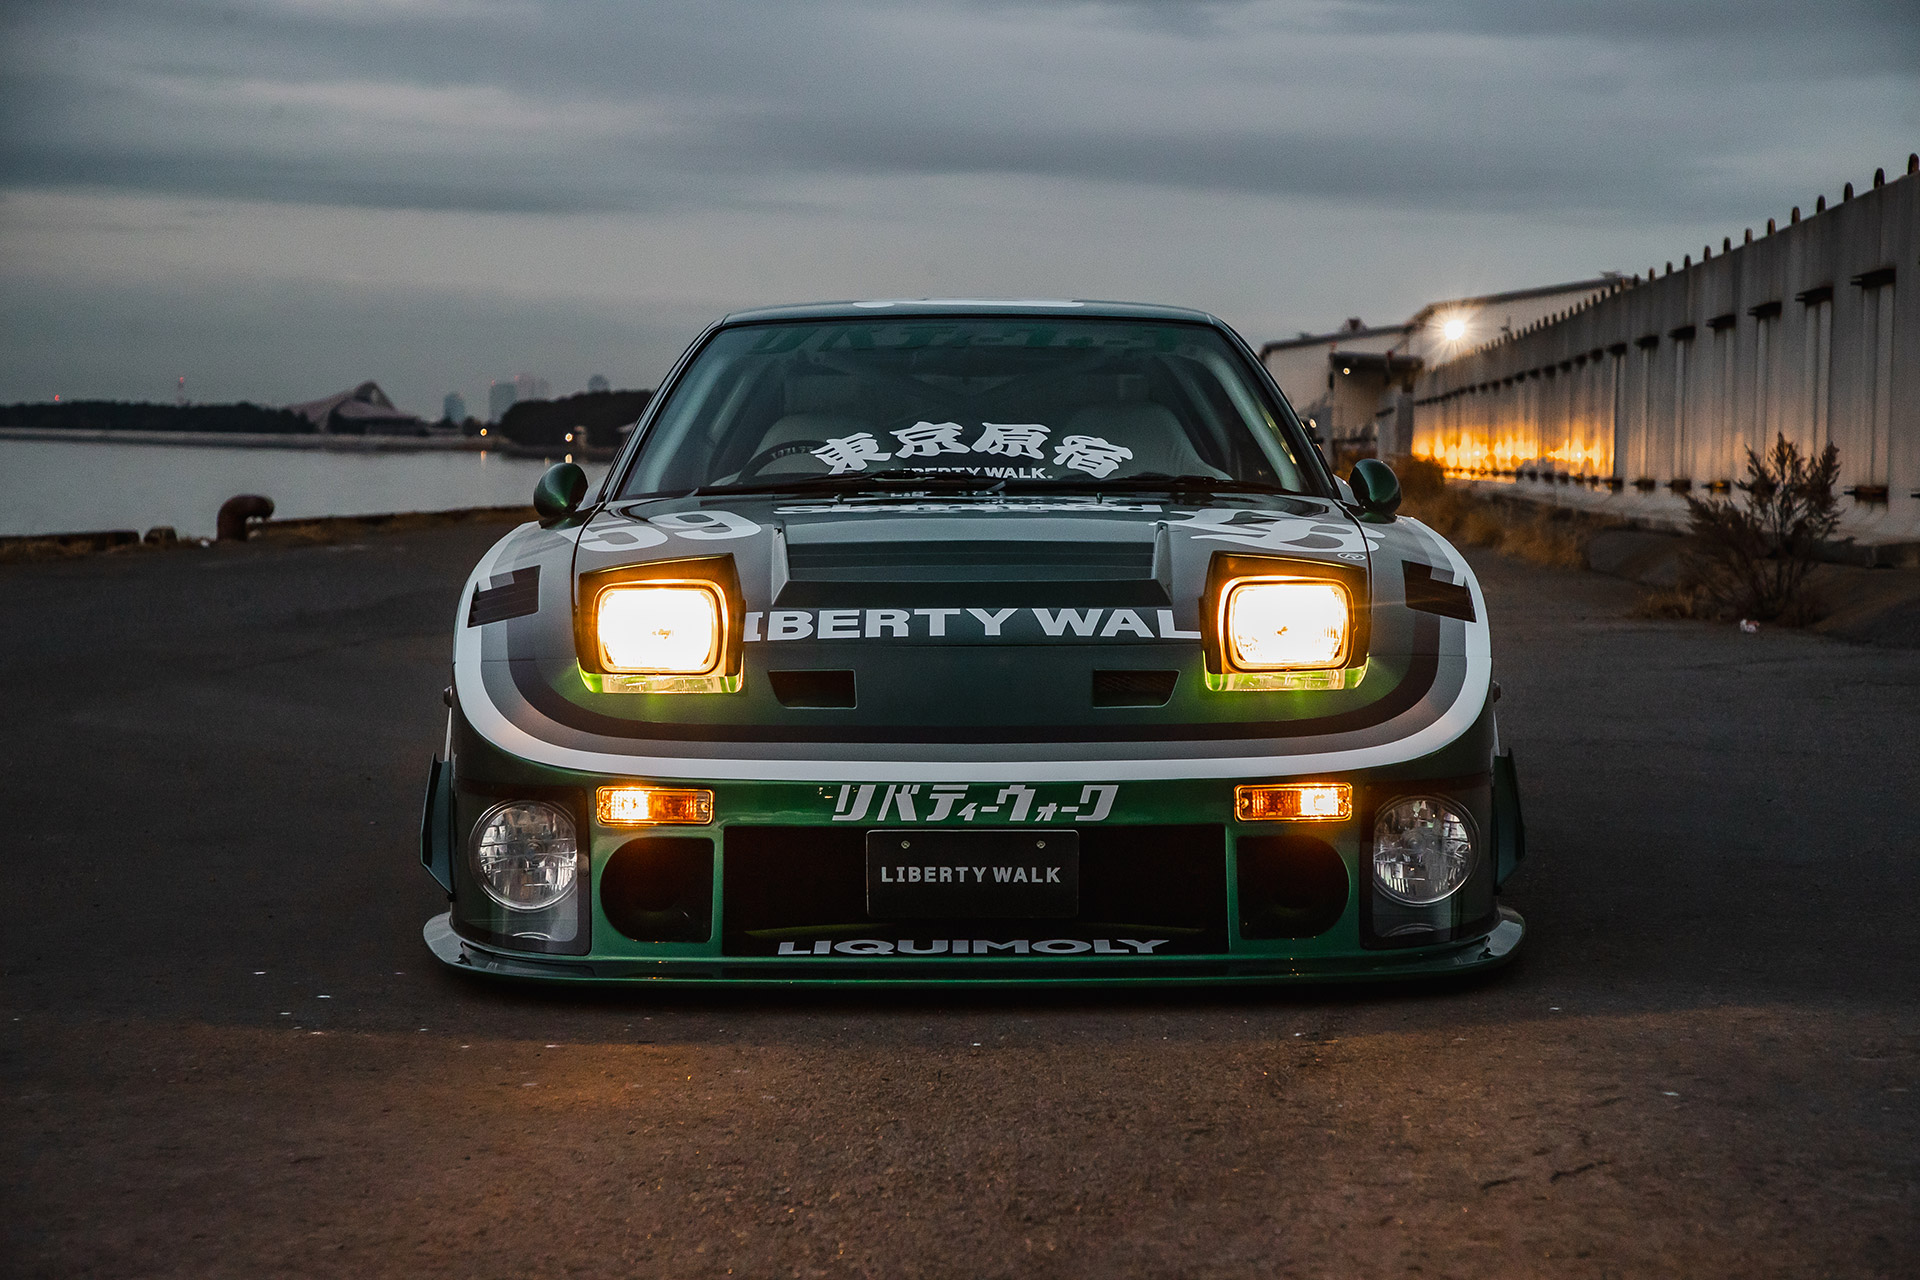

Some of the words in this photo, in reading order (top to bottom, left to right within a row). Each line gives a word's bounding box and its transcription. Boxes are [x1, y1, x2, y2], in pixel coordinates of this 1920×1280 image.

[811, 421, 1133, 478] 東京原宿
[559, 510, 762, 551] 59
[742, 607, 1018, 642] IBERTY
[1031, 607, 1201, 640] WAL
[832, 784, 1120, 822] リバティーウォーク
[881, 866, 987, 883] LIBERTY
[993, 866, 1061, 883] WALK
